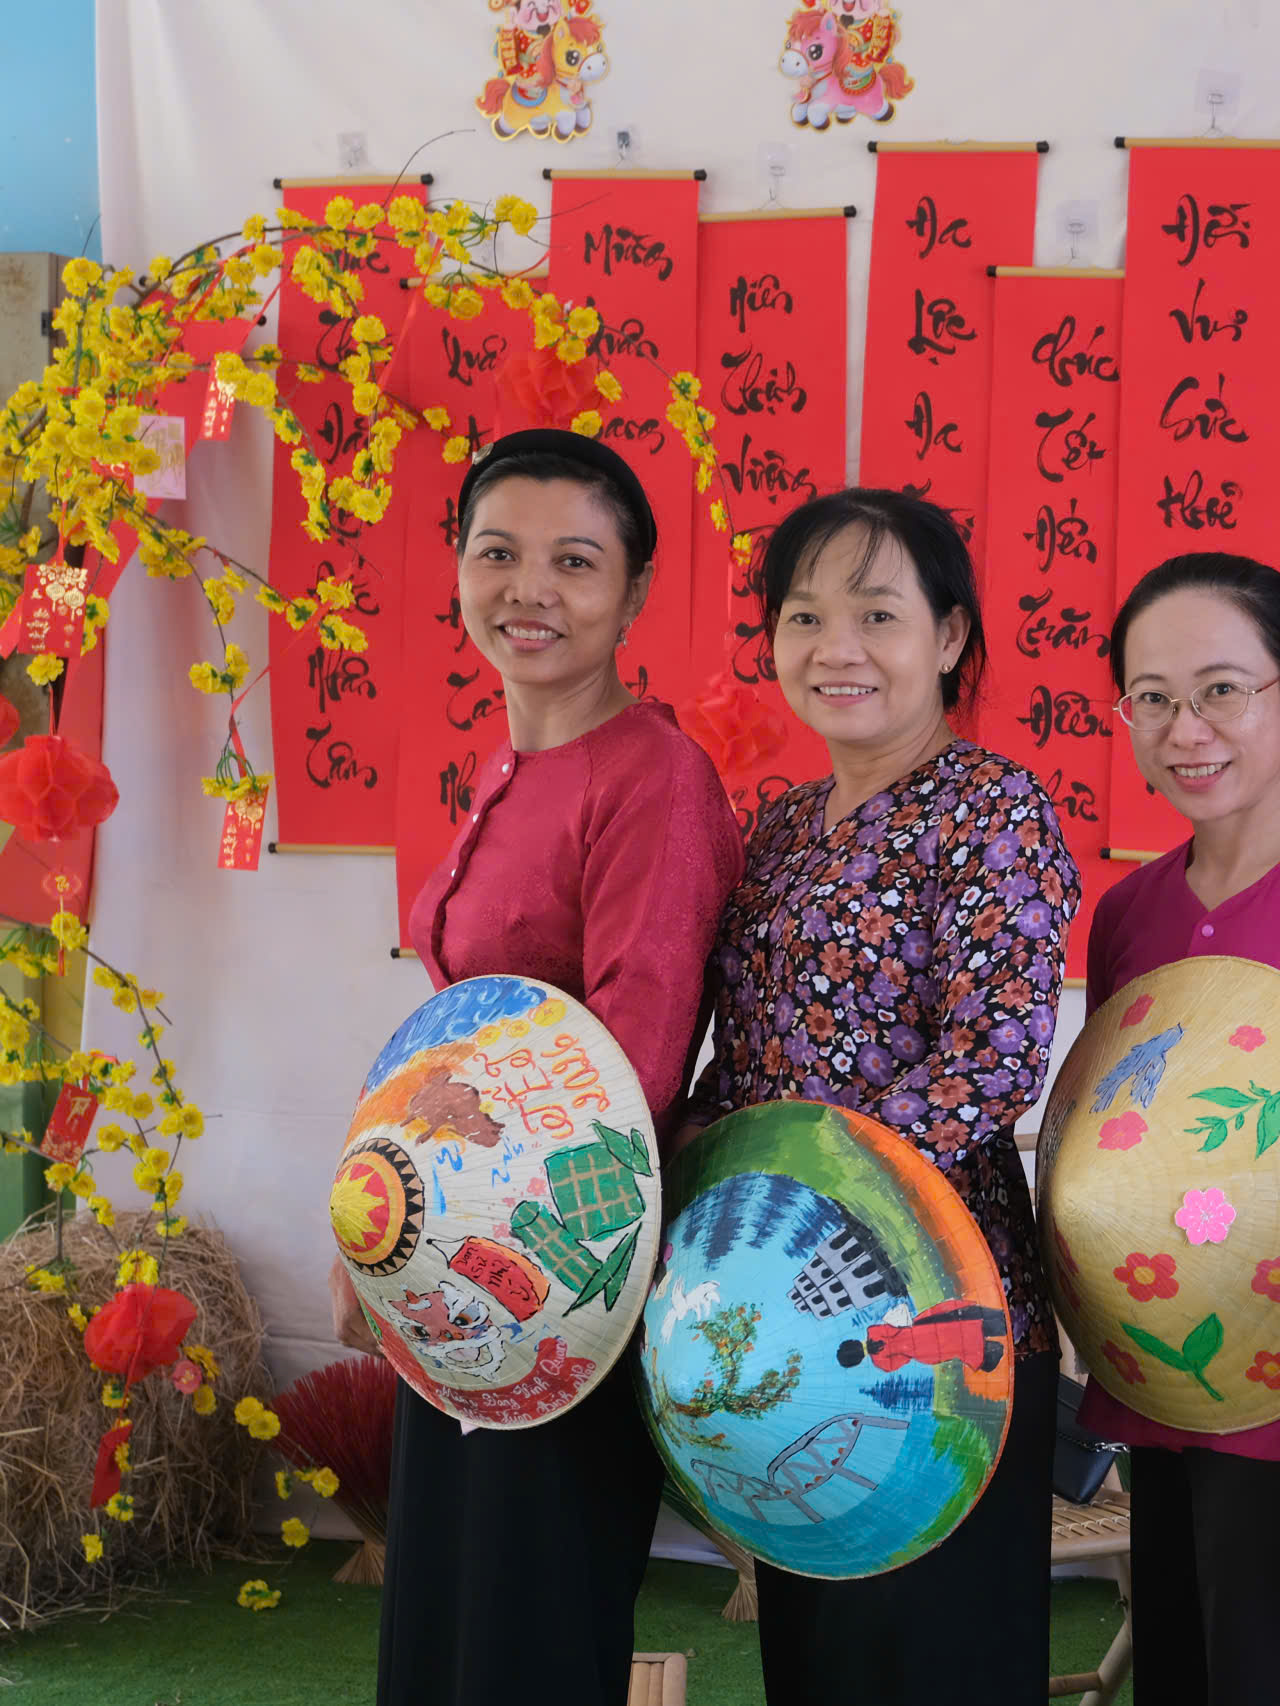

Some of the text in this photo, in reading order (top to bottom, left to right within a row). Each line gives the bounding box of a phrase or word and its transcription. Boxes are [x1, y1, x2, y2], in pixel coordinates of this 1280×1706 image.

[584, 223, 673, 281] Mừng
[906, 196, 972, 260] Đa
[729, 275, 793, 334] Niên
[907, 288, 978, 366] Lộc
[1169, 278, 1248, 344] Vui
[442, 328, 508, 387] Xuâ
[720, 343, 807, 416] Thịnh
[1032, 315, 1121, 388] Chúc
[594, 416, 665, 454] ang
[904, 391, 962, 461] Đa
[1160, 372, 1250, 443] Sức
[721, 433, 818, 505] Vượng
[1035, 408, 1107, 483] Tết
[1023, 498, 1098, 574] Đến
[1016, 588, 1112, 659] Trăm
[1016, 685, 1114, 750] Điều
[306, 720, 378, 789] Tâm
[541, 1033, 611, 1112] 2026
